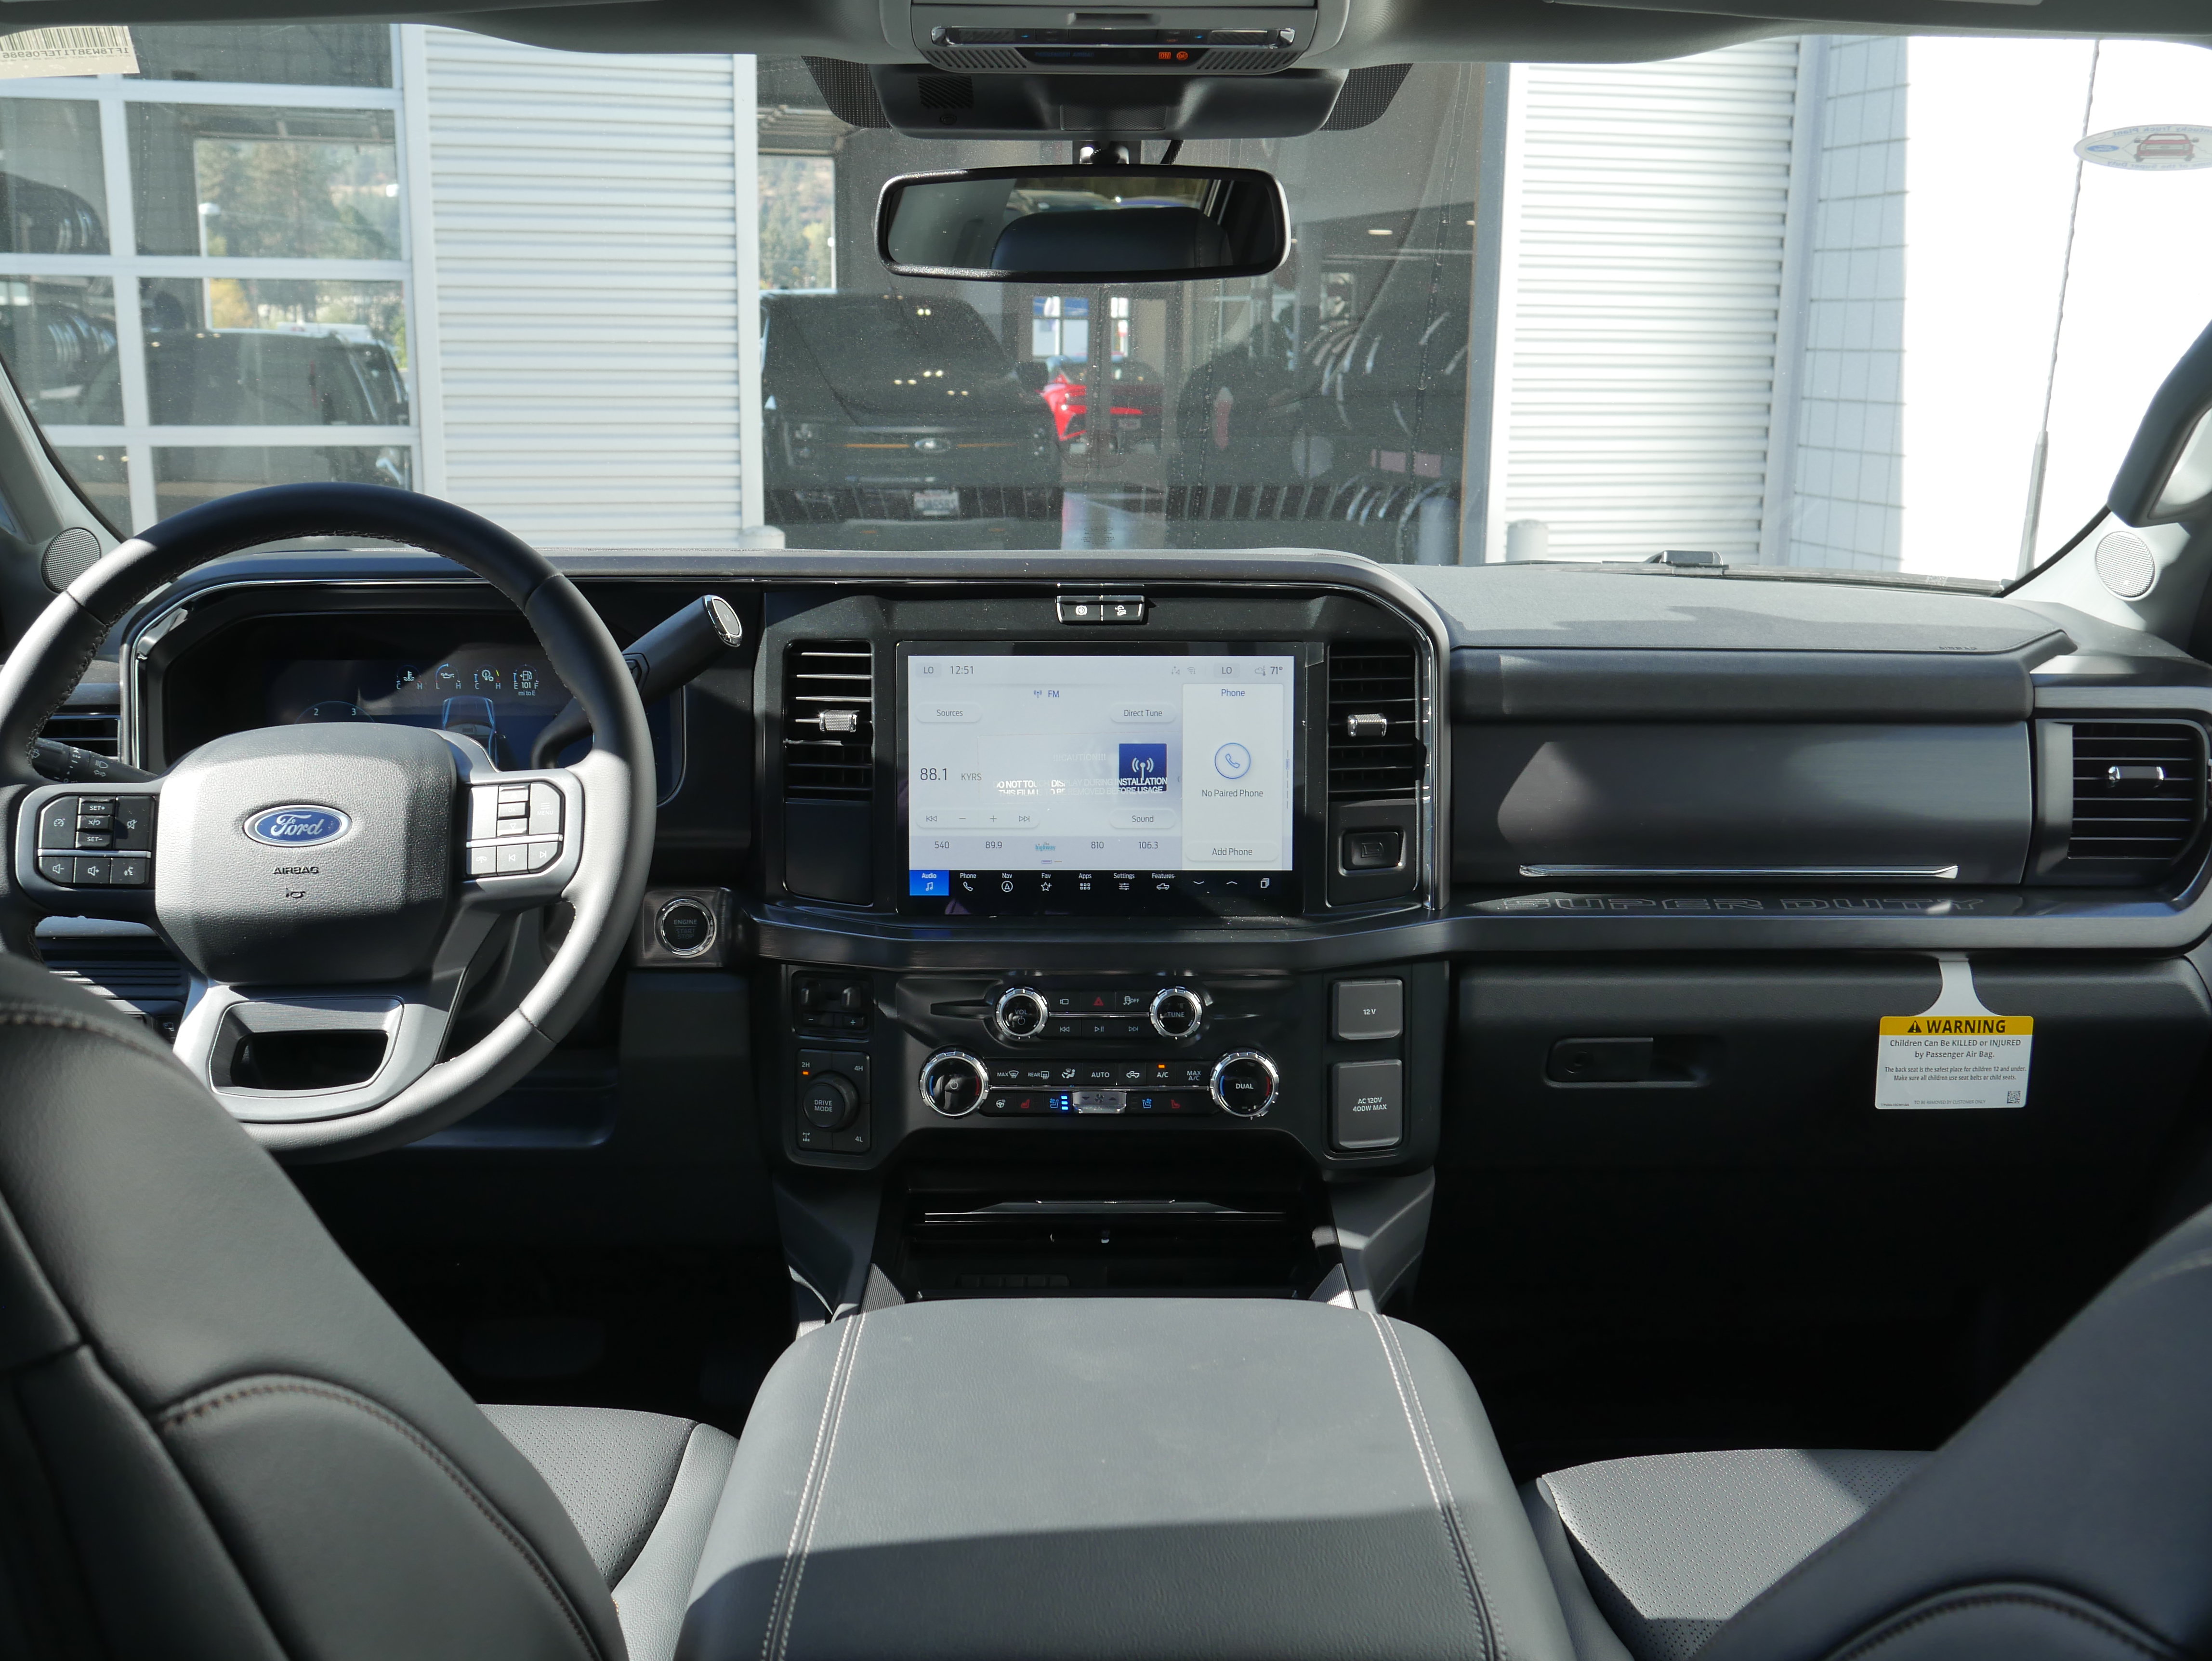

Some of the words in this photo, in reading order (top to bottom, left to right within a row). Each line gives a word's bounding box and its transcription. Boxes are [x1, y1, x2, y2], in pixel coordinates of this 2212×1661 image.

[949, 666, 974, 674] 12:51
[1221, 688, 1246, 697] Phone
[920, 768, 948, 780] 88.1
[1005, 780, 1022, 788] NOT
[1084, 778, 1114, 787] DURING
[1114, 777, 1168, 786] INSTALLATION
[1068, 788, 1105, 796] REMOVED
[1106, 787, 1136, 795] BEFORE
[1137, 786, 1163, 794] USAGE
[1213, 789, 1238, 797] Paired
[270, 813, 324, 837] Ford
[273, 866, 319, 875] AIRBAG
[1502, 897, 1763, 910] SUPER
[1779, 897, 1985, 910] DUTY
[1926, 1020, 2006, 1033] WARNING
[1989, 1039, 2021, 1047] INJURED
[1915, 1051, 1924, 1059] by
[1926, 1051, 1964, 1059] Passenger
[1979, 1051, 1995, 1059] Bag.
